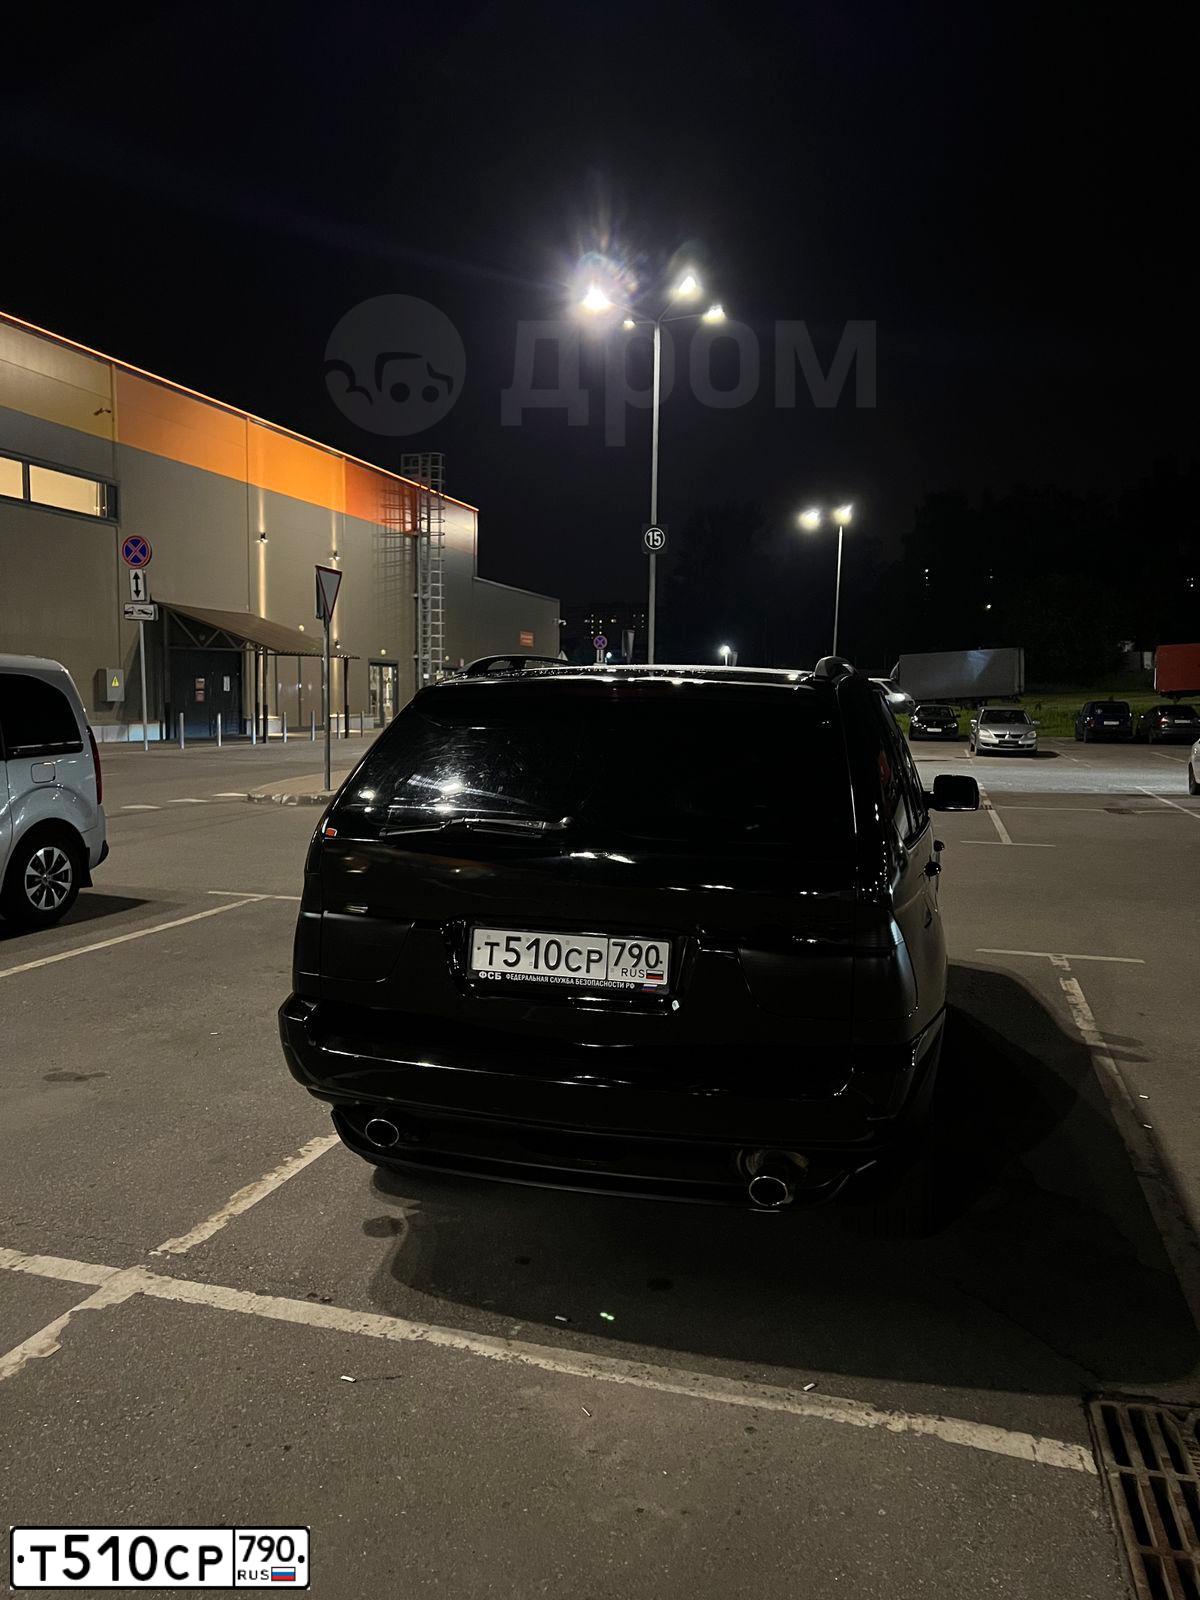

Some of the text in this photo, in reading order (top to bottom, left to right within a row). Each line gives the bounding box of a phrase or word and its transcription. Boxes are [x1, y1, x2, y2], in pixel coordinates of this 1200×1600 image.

[647, 531, 662, 546] 15
[484, 936, 603, 974] Т510СР
[611, 941, 660, 969] 790
[478, 971, 635, 990] ФСБ ФЕДЕРАЛЬНАЯ СЛУЖБА БЕЗОПАСНОСТИ РФ
[621, 967, 645, 979] RUS
